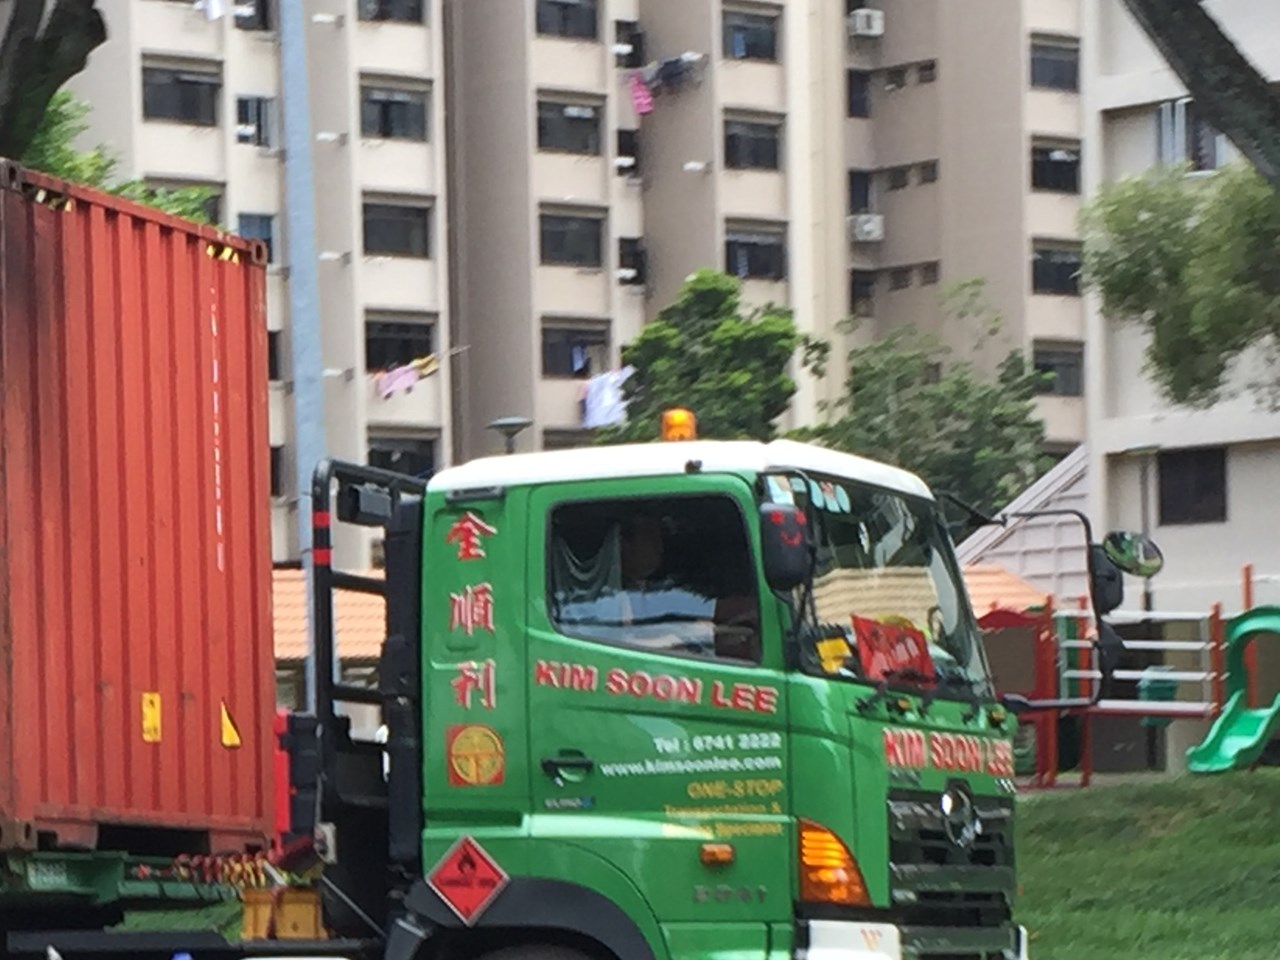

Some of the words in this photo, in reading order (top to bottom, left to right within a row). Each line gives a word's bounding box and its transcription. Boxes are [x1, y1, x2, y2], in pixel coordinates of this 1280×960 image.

[535, 659, 598, 692] KIM
[605, 668, 703, 705] SOON
[711, 680, 780, 714] LEE
[883, 727, 928, 769] KIM
[929, 731, 984, 774] SOON
[982, 737, 1015, 777] LEE
[687, 779, 784, 799] ONE-STOP
